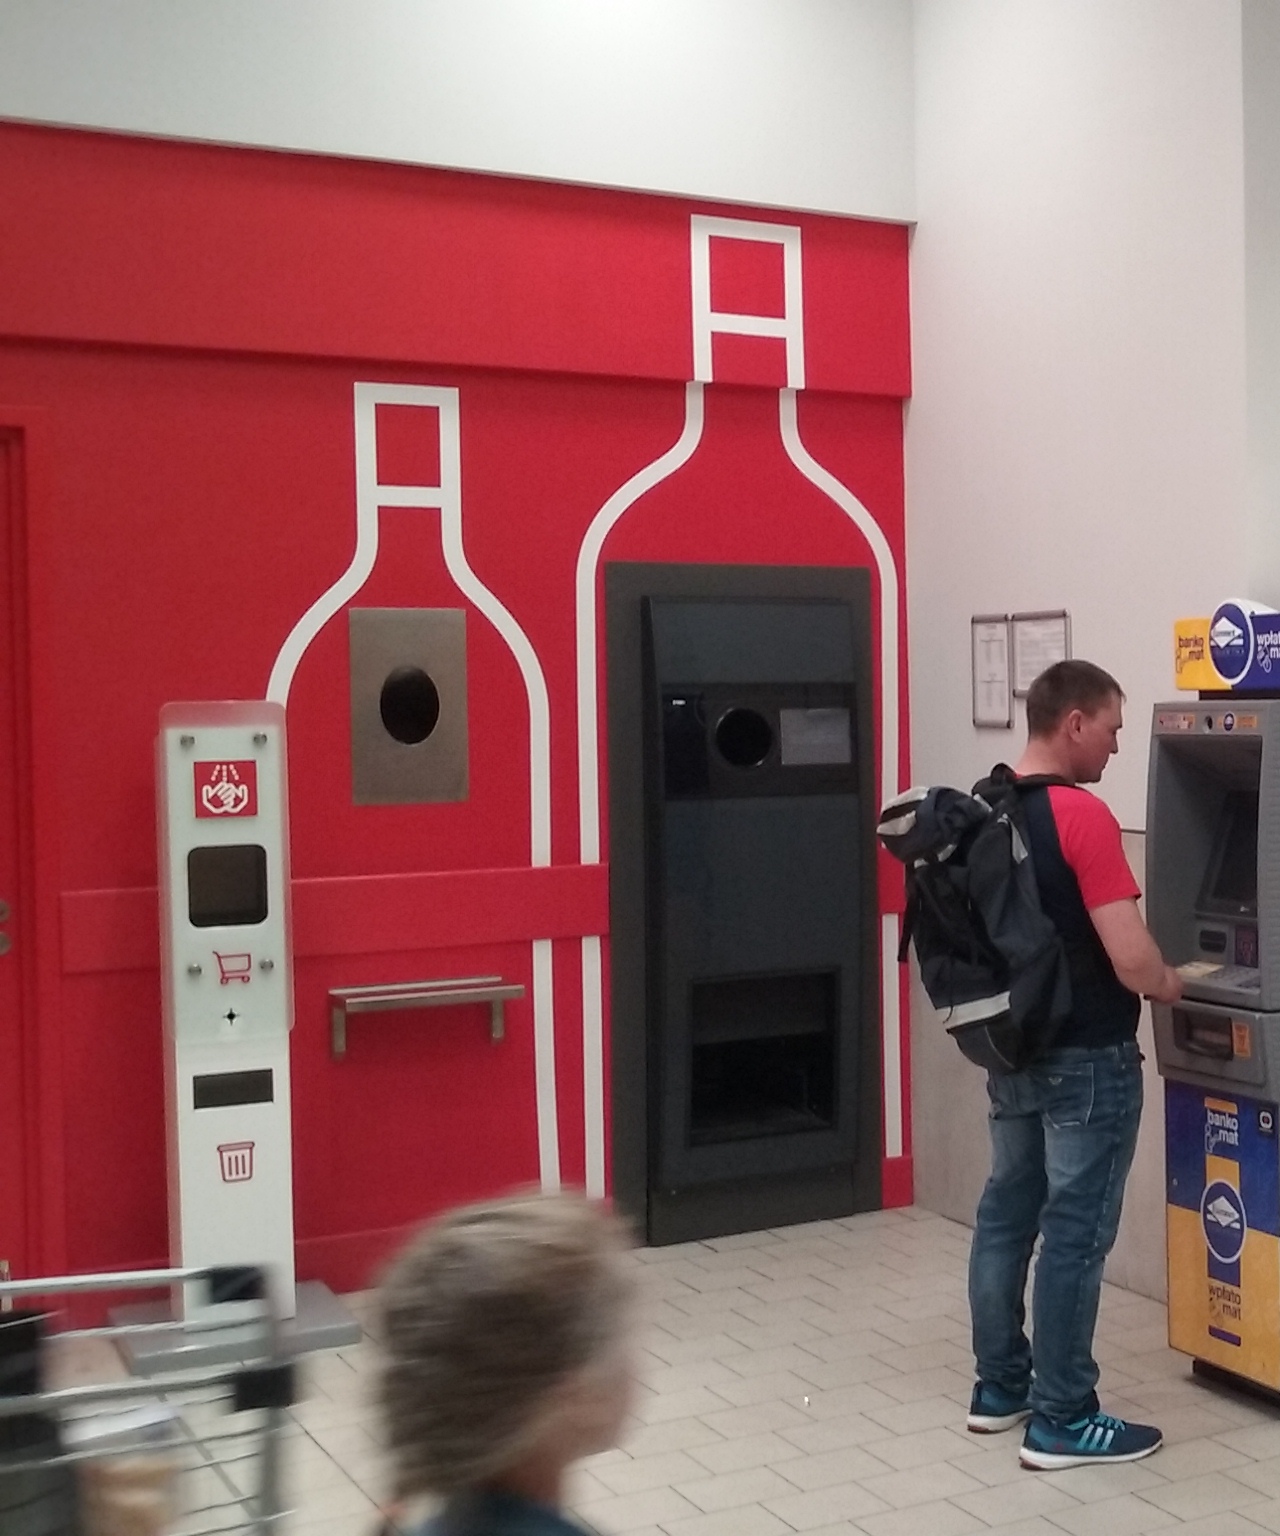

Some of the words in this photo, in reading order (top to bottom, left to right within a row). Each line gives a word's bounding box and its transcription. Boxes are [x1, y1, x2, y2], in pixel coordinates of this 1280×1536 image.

[1178, 635, 1205, 648] banko
[1188, 649, 1205, 660] mat
[1206, 1108, 1239, 1131] banko
[1218, 1129, 1239, 1147] mat
